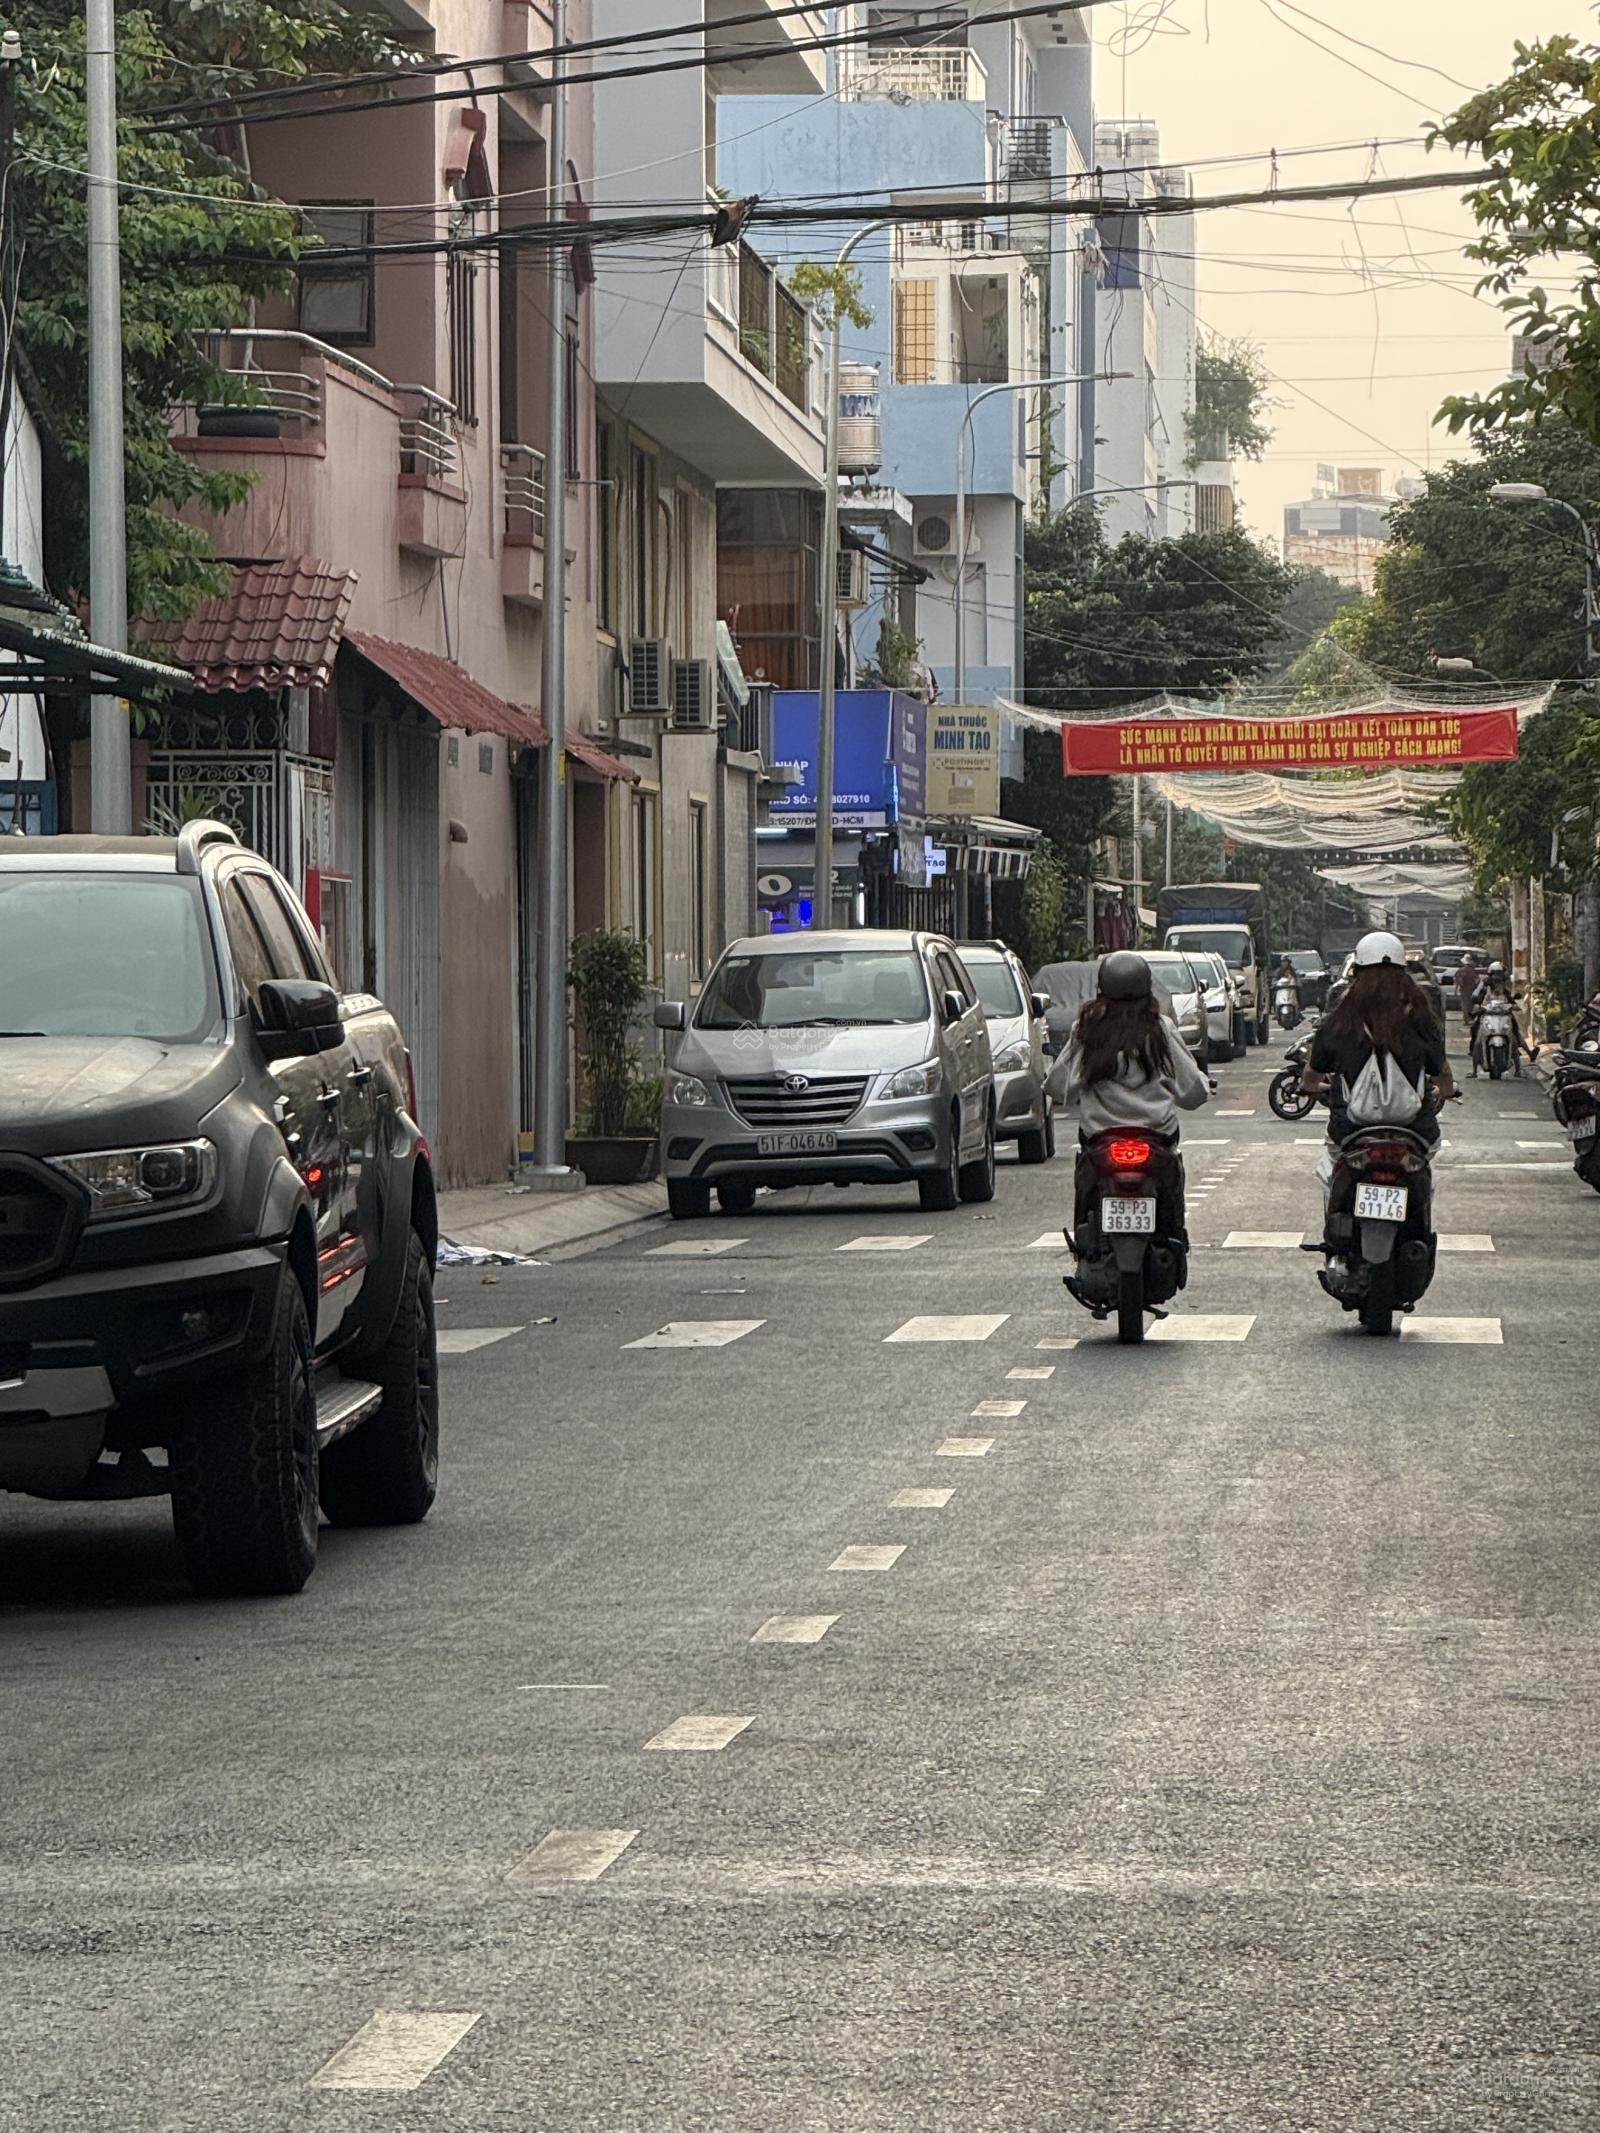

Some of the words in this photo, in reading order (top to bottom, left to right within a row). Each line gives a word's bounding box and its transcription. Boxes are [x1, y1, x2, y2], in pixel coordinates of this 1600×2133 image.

[934, 730, 965, 750] MINH
[967, 731, 991, 754] TẠO
[1119, 725, 1142, 745] SỨC
[1145, 727, 1177, 746] MẠNH
[1180, 723, 1201, 743] CỦA
[1205, 722, 1233, 742] NHÂN
[1237, 722, 1261, 741] DÂN
[1262, 722, 1276, 740] VÀ
[1279, 721, 1305, 740] KHỐI
[1362, 718, 1381, 737] KẾT
[1384, 717, 1412, 737] TOÀN
[1440, 717, 1461, 738] TỘC
[1119, 745, 1133, 765] LÀ
[1136, 744, 1165, 765] NHÂN
[1168, 744, 1182, 763] TỐ
[1185, 742, 1218, 763] QUYẾT
[1221, 744, 1247, 764] ĐỊNH
[1250, 742, 1285, 760] THÀNH
[1288, 742, 1306, 762] BẠI
[1310, 740, 1331, 759] CỦA
[1334, 741, 1349, 761] SỰ
[1352, 738, 1391, 760] NGHIỆP
[1394, 737, 1423, 756] CÁCH
[1426, 738, 1462, 759] MẠNG!
[1363, 1186, 1402, 1204] 59-P2
[1109, 1200, 1148, 1215] 59-P3
